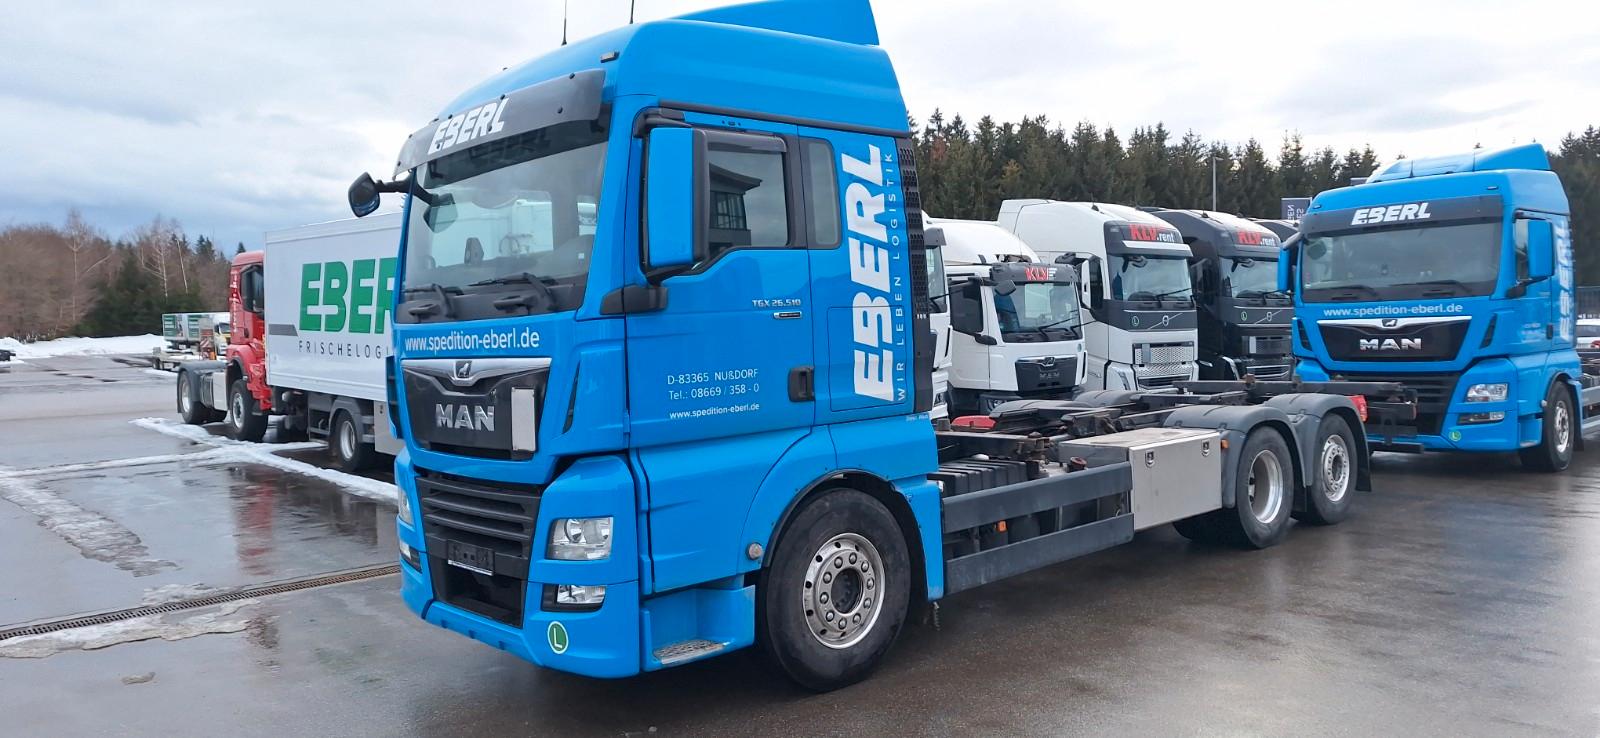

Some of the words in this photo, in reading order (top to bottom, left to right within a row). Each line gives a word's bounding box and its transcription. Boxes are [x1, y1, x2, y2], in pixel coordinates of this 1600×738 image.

[427, 98, 509, 155] EBERL
[884, 153, 900, 260] LOGISTIK
[1351, 202, 1431, 226] EBERL
[841, 144, 894, 401] EBERL
[752, 299, 770, 307] TGX
[772, 298, 801, 307] 26.510
[893, 276, 904, 346] LEBEN
[1323, 303, 1464, 317] www.spedition-eberl.de
[405, 327, 540, 356] www.spedition-eberl.de
[1359, 338, 1422, 350] MAN
[667, 372, 709, 385] D-83365
[669, 390, 688, 400] Tel.:
[691, 386, 722, 399] 08669
[729, 384, 746, 395] 358
[753, 383, 760, 393] 0
[897, 362, 906, 401] WIR
[435, 404, 495, 432] MAN
[669, 402, 760, 419] www.spedition-eberl.de
